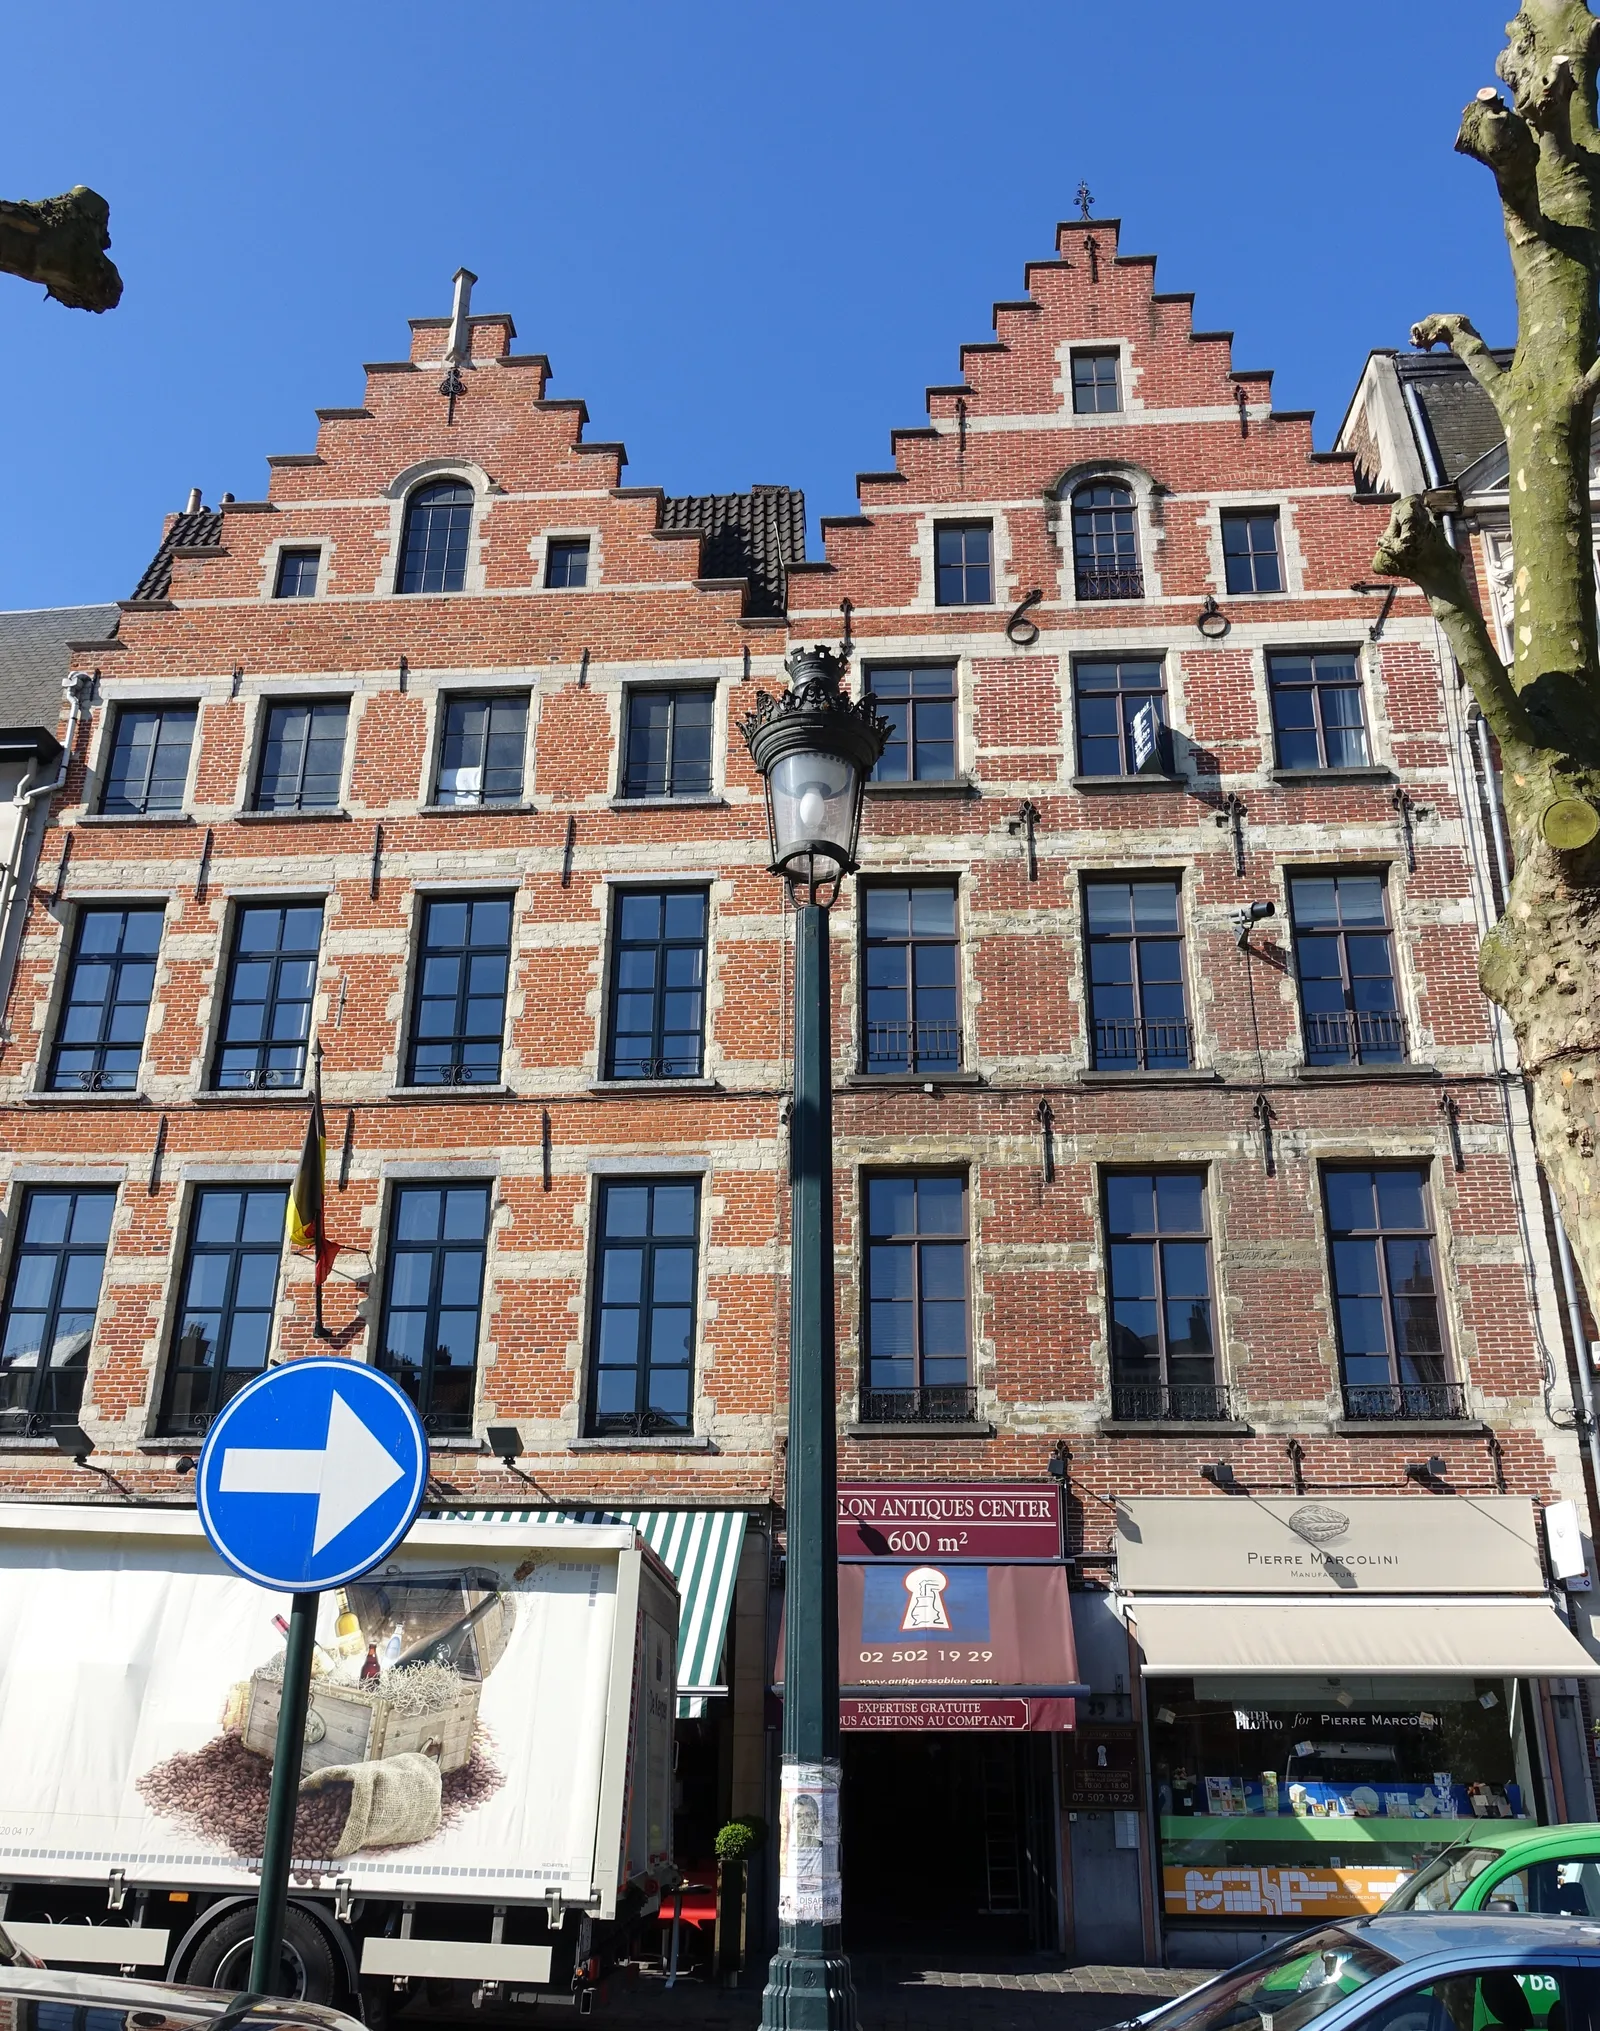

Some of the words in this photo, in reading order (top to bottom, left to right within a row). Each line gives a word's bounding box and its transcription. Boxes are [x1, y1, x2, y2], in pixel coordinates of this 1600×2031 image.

[838, 1498, 876, 1516] LON
[880, 1499, 974, 1520] ANTIQUES
[978, 1499, 1052, 1518] CENTER
[887, 1530, 931, 1552] 600
[1247, 1552, 1303, 1565] PIERRE
[1310, 1552, 1399, 1565] MARCOLINI
[1290, 1570, 1357, 1578] MANUFACTURE
[859, 1651, 884, 1663] 02
[891, 1649, 928, 1663] 502
[938, 1650, 961, 1662] 19
[968, 1650, 993, 1662] 29
[857, 1703, 918, 1713] EXPERTISE
[920, 1703, 981, 1713] GRATUITE
[860, 1715, 924, 1726] ACHETONS
[927, 1715, 944, 1725] AU
[947, 1715, 1016, 1726] COMPTANT
[1236, 1720, 1283, 1730] PILOTTO
[1291, 1712, 1312, 1729] for
[1321, 1715, 1366, 1725] PIERRE
[1072, 1793, 1083, 1801] 02
[1087, 1793, 1104, 1801] 502
[1108, 1793, 1119, 1801] 19
[1122, 1794, 1134, 1802] 29
[12, 1827, 21, 1835] 04
[25, 1828, 34, 1836] 17
